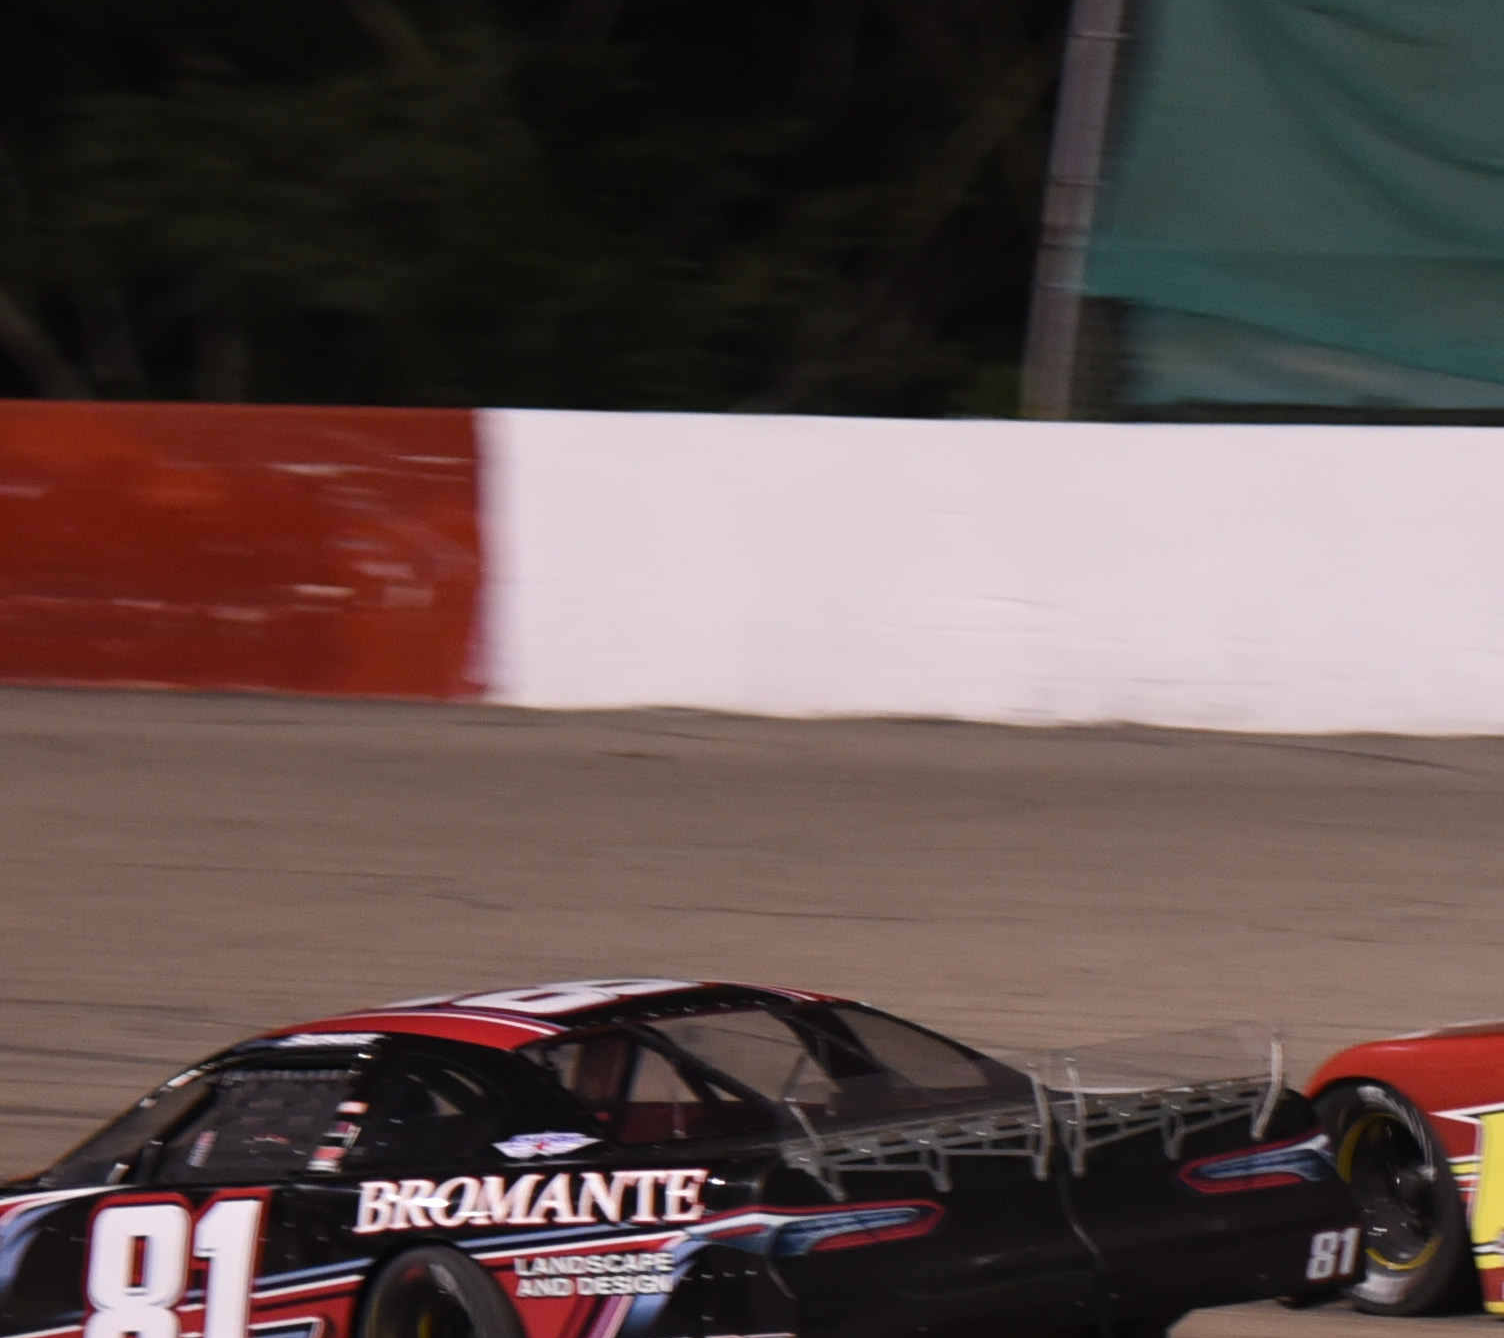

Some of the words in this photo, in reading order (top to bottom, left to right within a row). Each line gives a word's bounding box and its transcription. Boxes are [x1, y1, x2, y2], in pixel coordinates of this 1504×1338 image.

[352, 1169, 709, 1234] BROMANTE
[514, 1253, 676, 1277] LANDSCAPE
[1305, 1228, 1360, 1280] 81
[516, 1277, 575, 1298] AND
[576, 1274, 674, 1296] DESIGN
